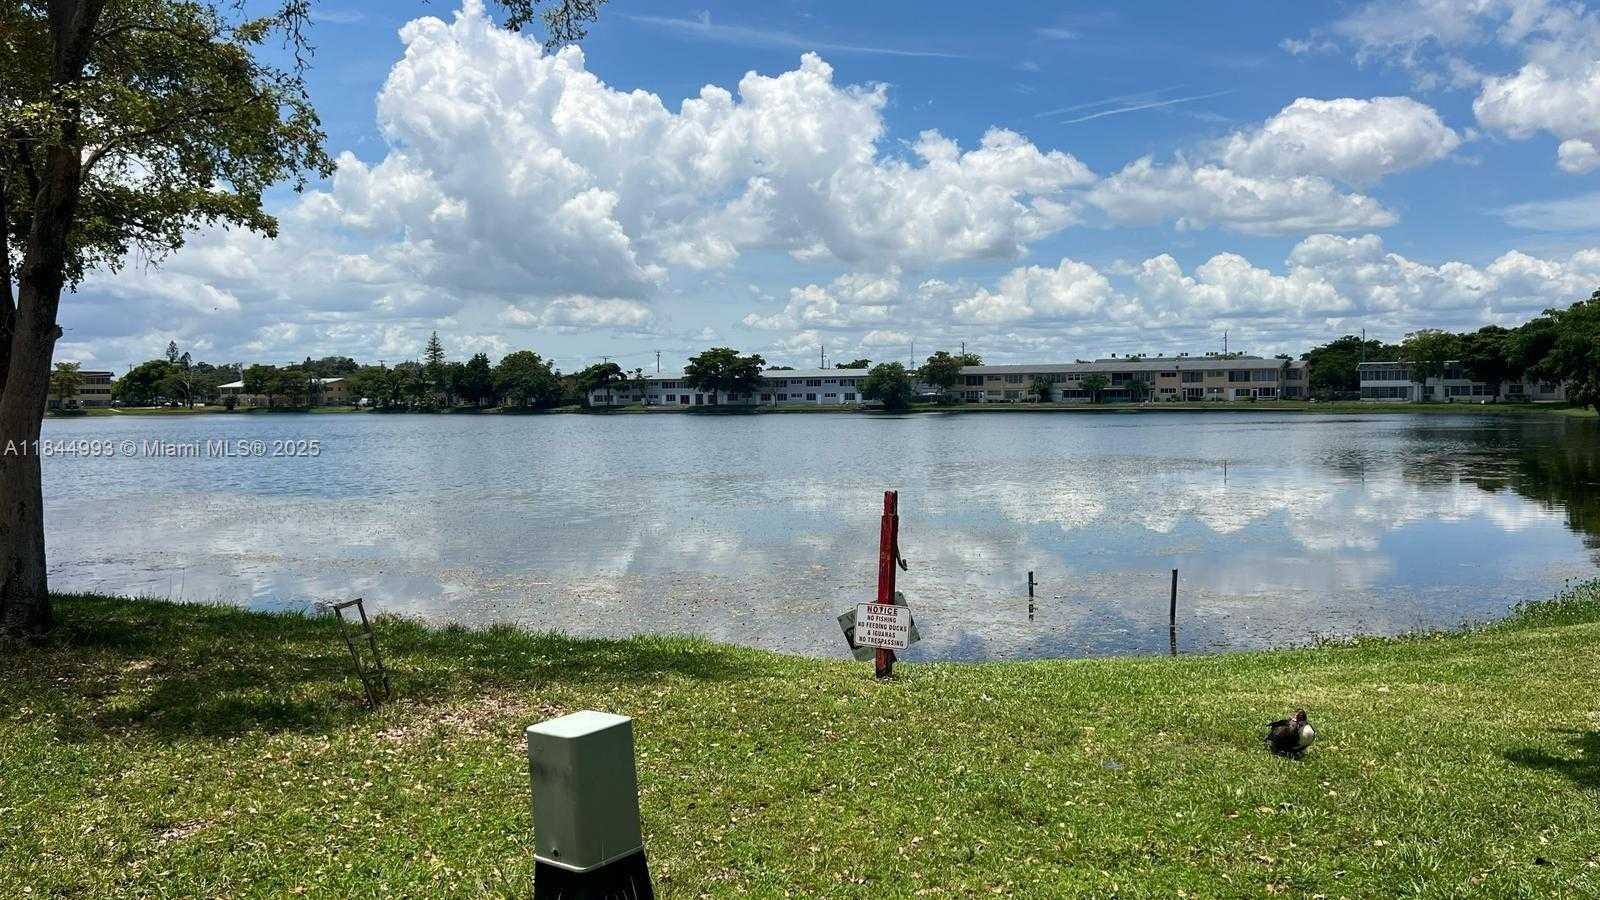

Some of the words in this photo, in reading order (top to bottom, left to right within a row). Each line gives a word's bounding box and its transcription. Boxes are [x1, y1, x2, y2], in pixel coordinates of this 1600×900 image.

[867, 605, 898, 615] NOTICE
[866, 622, 887, 630] FEEDING
[889, 624, 907, 632] DUCKS
[872, 630, 896, 638] IGUANAS
[868, 637, 904, 646] TRESPASSING
